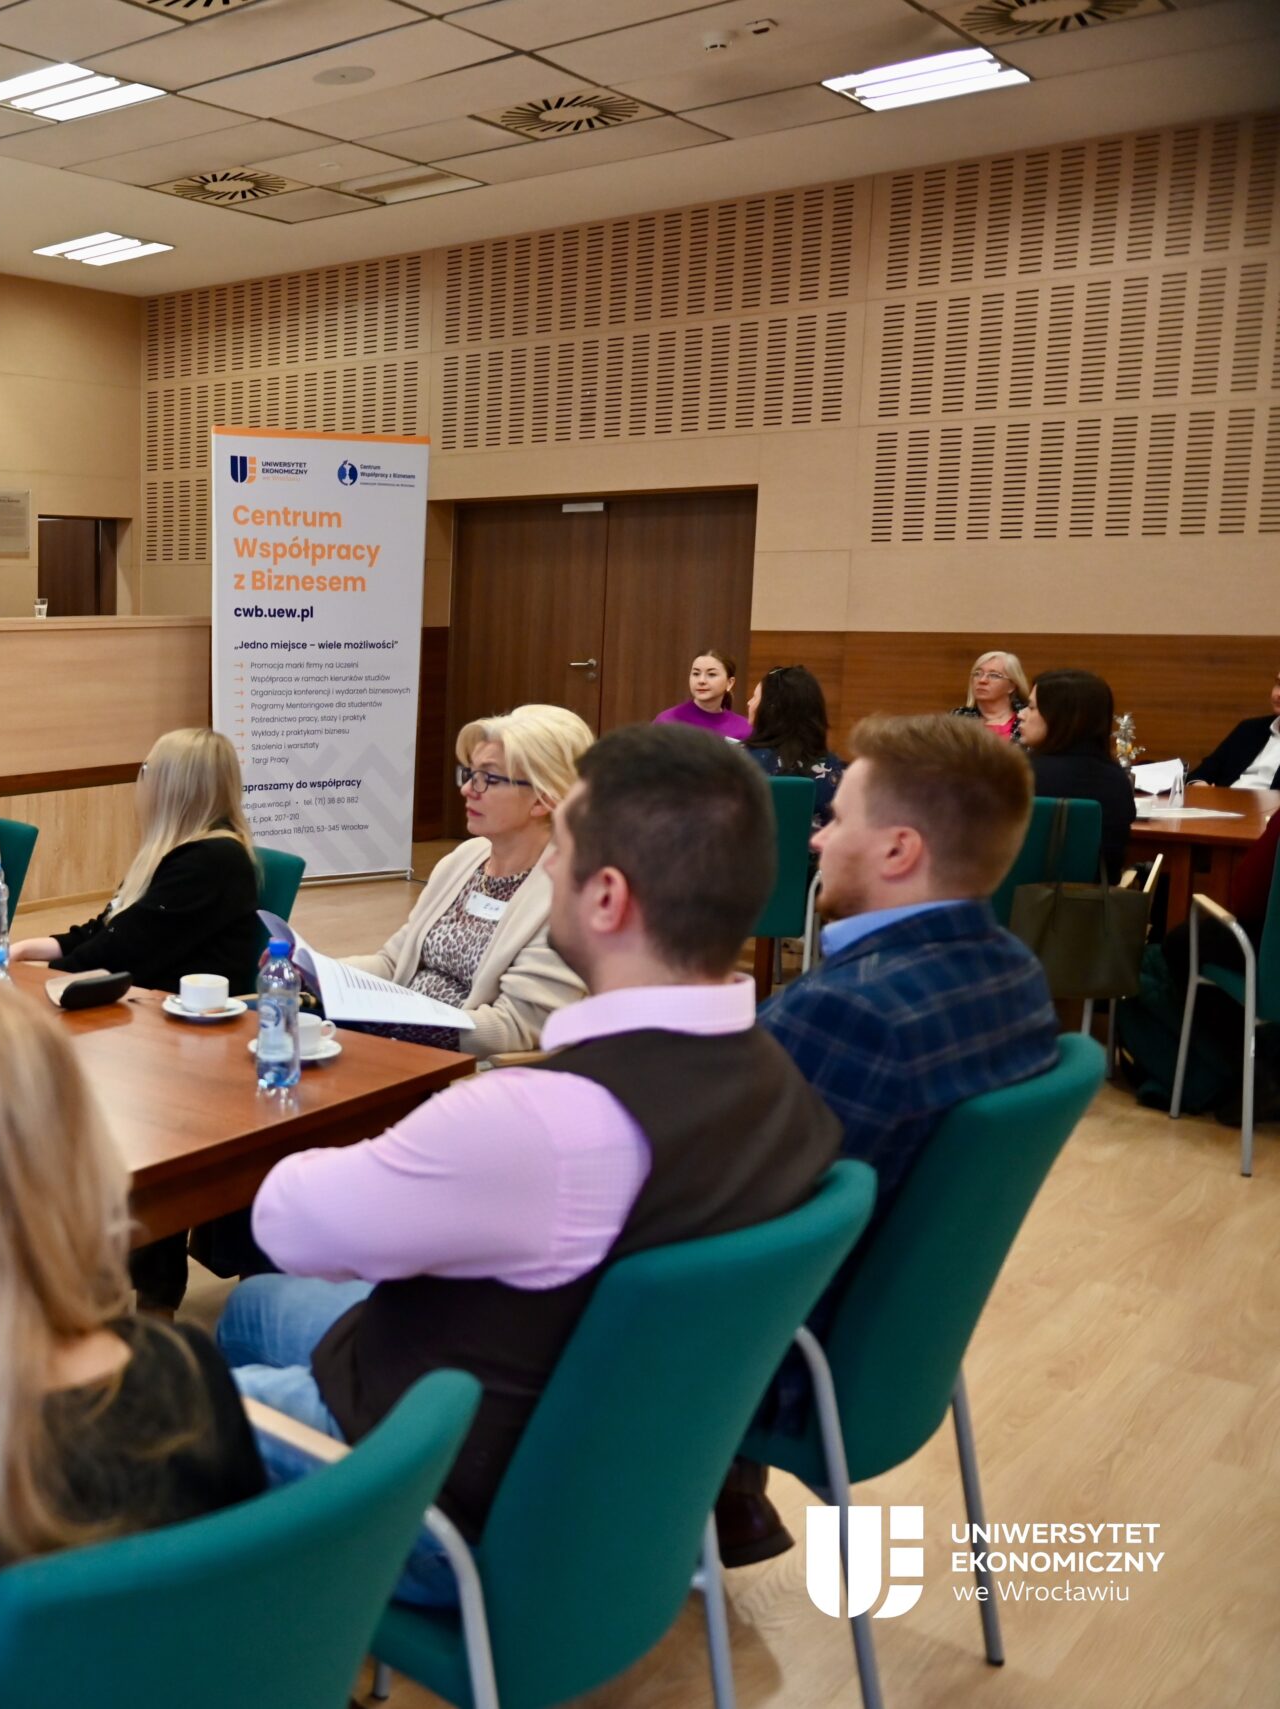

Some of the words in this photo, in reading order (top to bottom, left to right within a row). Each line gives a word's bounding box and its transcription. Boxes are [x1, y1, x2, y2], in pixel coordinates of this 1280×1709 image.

[233, 505, 342, 529] Centrum
[233, 536, 381, 567] Współpracy
[233, 575, 245, 591] z
[251, 569, 367, 592] Biznesem
[233, 605, 314, 622] cwb.uew.pl
[270, 640, 307, 652] miejsce
[318, 640, 342, 650] wiele
[250, 662, 284, 670] Promocja
[306, 661, 323, 670] firmy
[250, 675, 293, 684] Współpraca
[330, 674, 363, 682] kierunków
[365, 673, 390, 681] studiów
[250, 689, 292, 698] Organizacja
[294, 688, 331, 697] konferencji
[335, 688, 368, 696] wydarzeń
[369, 687, 411, 696] biznesowych
[251, 702, 284, 711] Programy
[286, 702, 334, 710] Mentoringowe
[348, 700, 382, 708] studentów
[342, 714, 367, 723] praktyk
[251, 729, 279, 738] Wykłady
[286, 728, 323, 737] praktykami
[251, 743, 283, 751] Szkolenia
[287, 742, 320, 751] warsztaty
[251, 757, 269, 766] Targi
[269, 756, 289, 765] Pracy
[241, 782, 294, 794] apraszamy
[295, 780, 308, 789] do
[309, 778, 362, 791] współpracy
